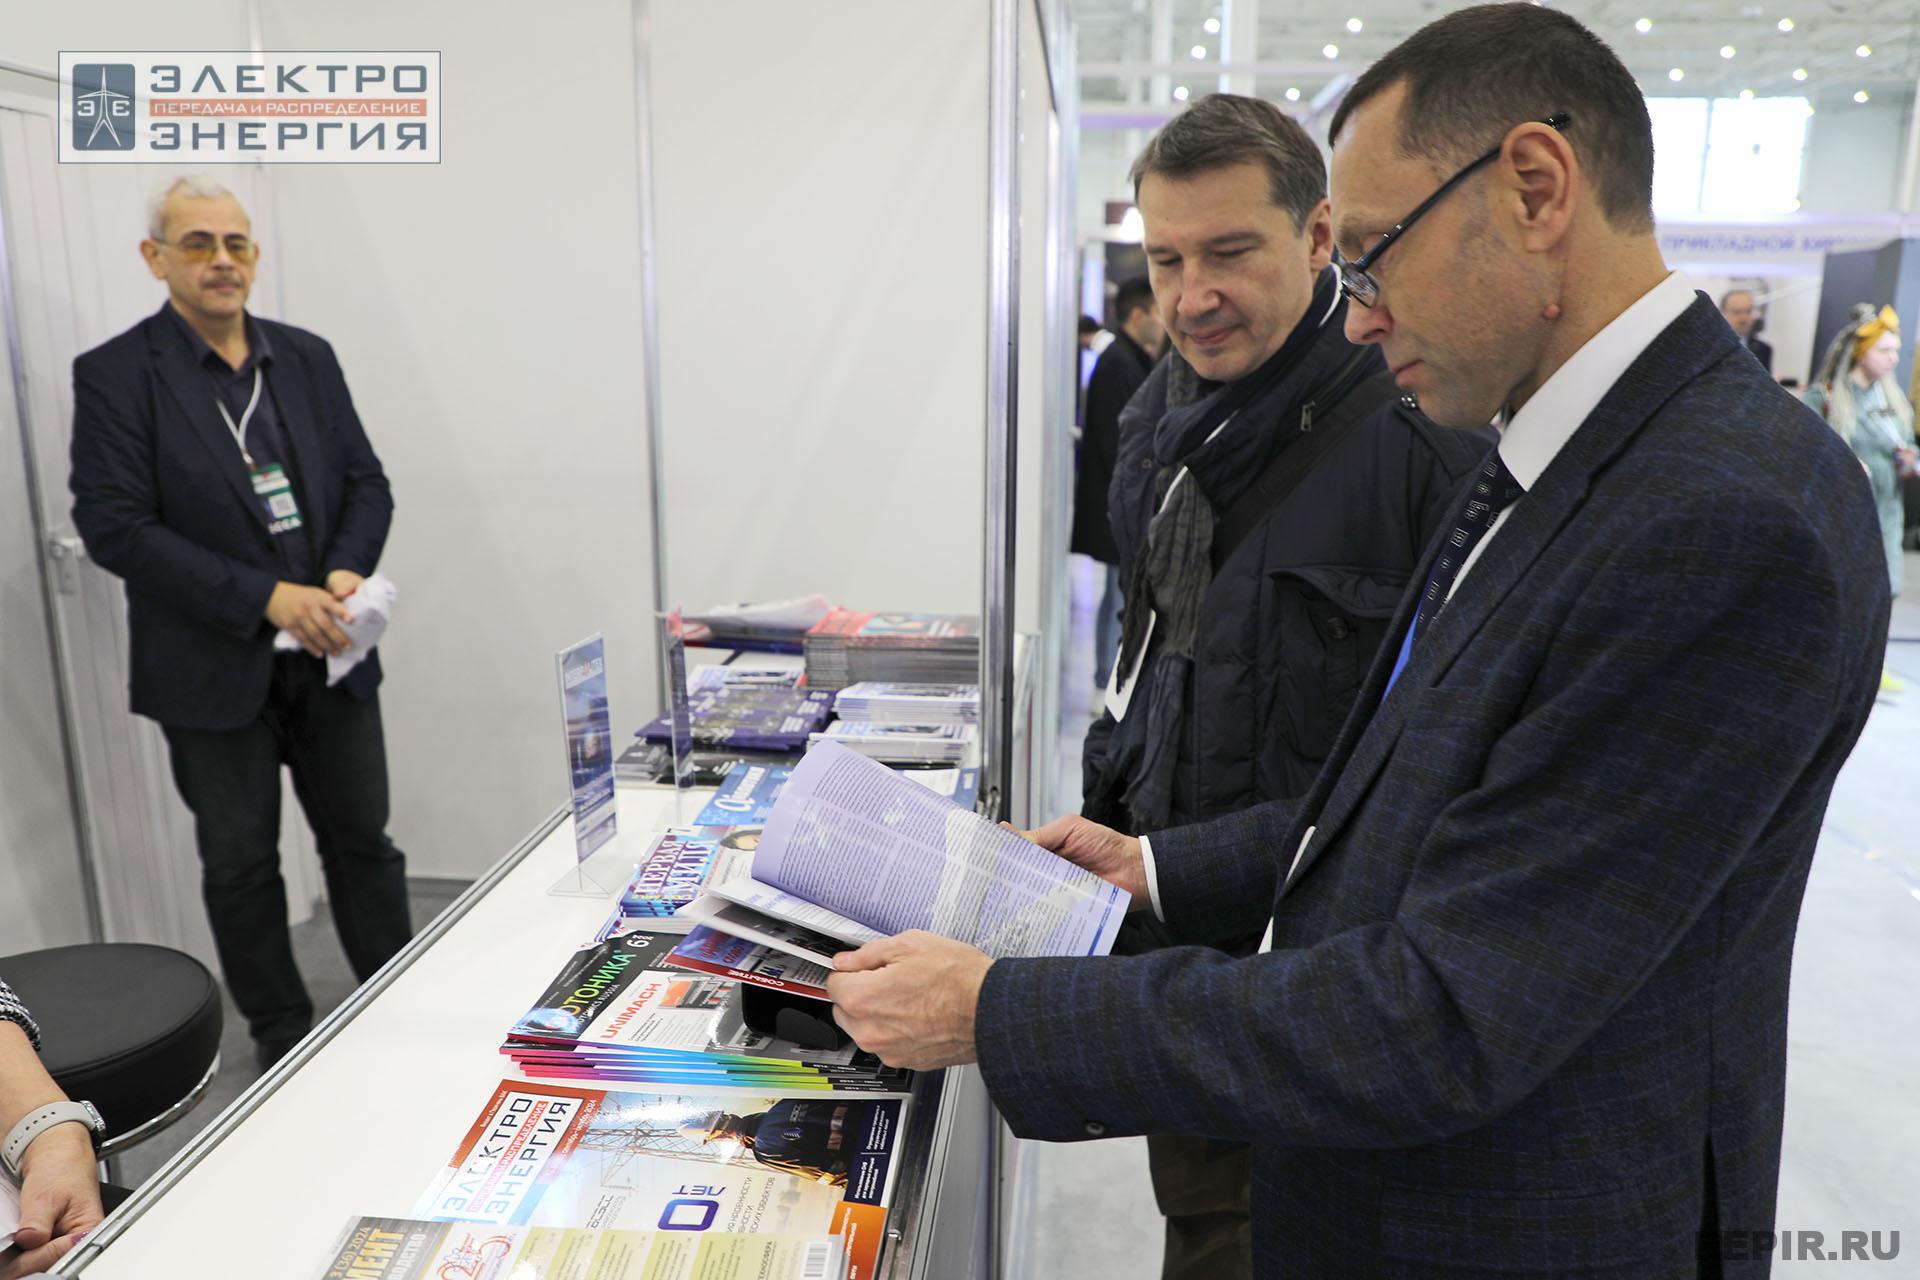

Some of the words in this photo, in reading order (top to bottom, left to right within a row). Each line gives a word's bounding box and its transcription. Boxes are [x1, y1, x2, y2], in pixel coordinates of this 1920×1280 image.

[635, 842, 683, 896] ПЕРВАЯ
[661, 840, 719, 896] МИЛЯ
[560, 953, 637, 1017] ОТОНИКА
[600, 983, 662, 1039] UNIMACH
[485, 1102, 571, 1214] ЭНЕРГИЯ
[350, 1227, 371, 1249] 2024
